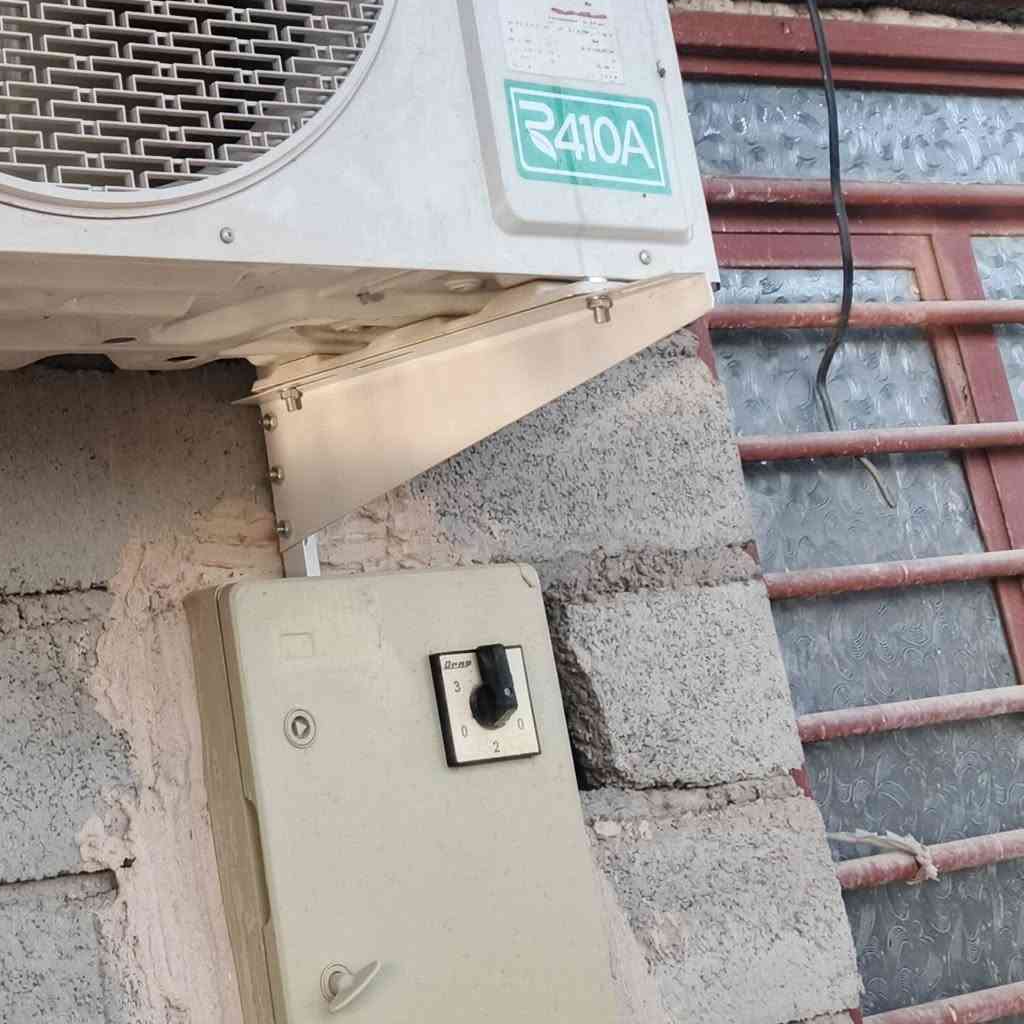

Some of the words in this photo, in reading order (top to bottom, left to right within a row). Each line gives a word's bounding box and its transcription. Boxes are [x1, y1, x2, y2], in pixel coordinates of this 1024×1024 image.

[518, 99, 656, 169] R410A
[453, 680, 462, 693] 3
[492, 740, 501, 753] 2
